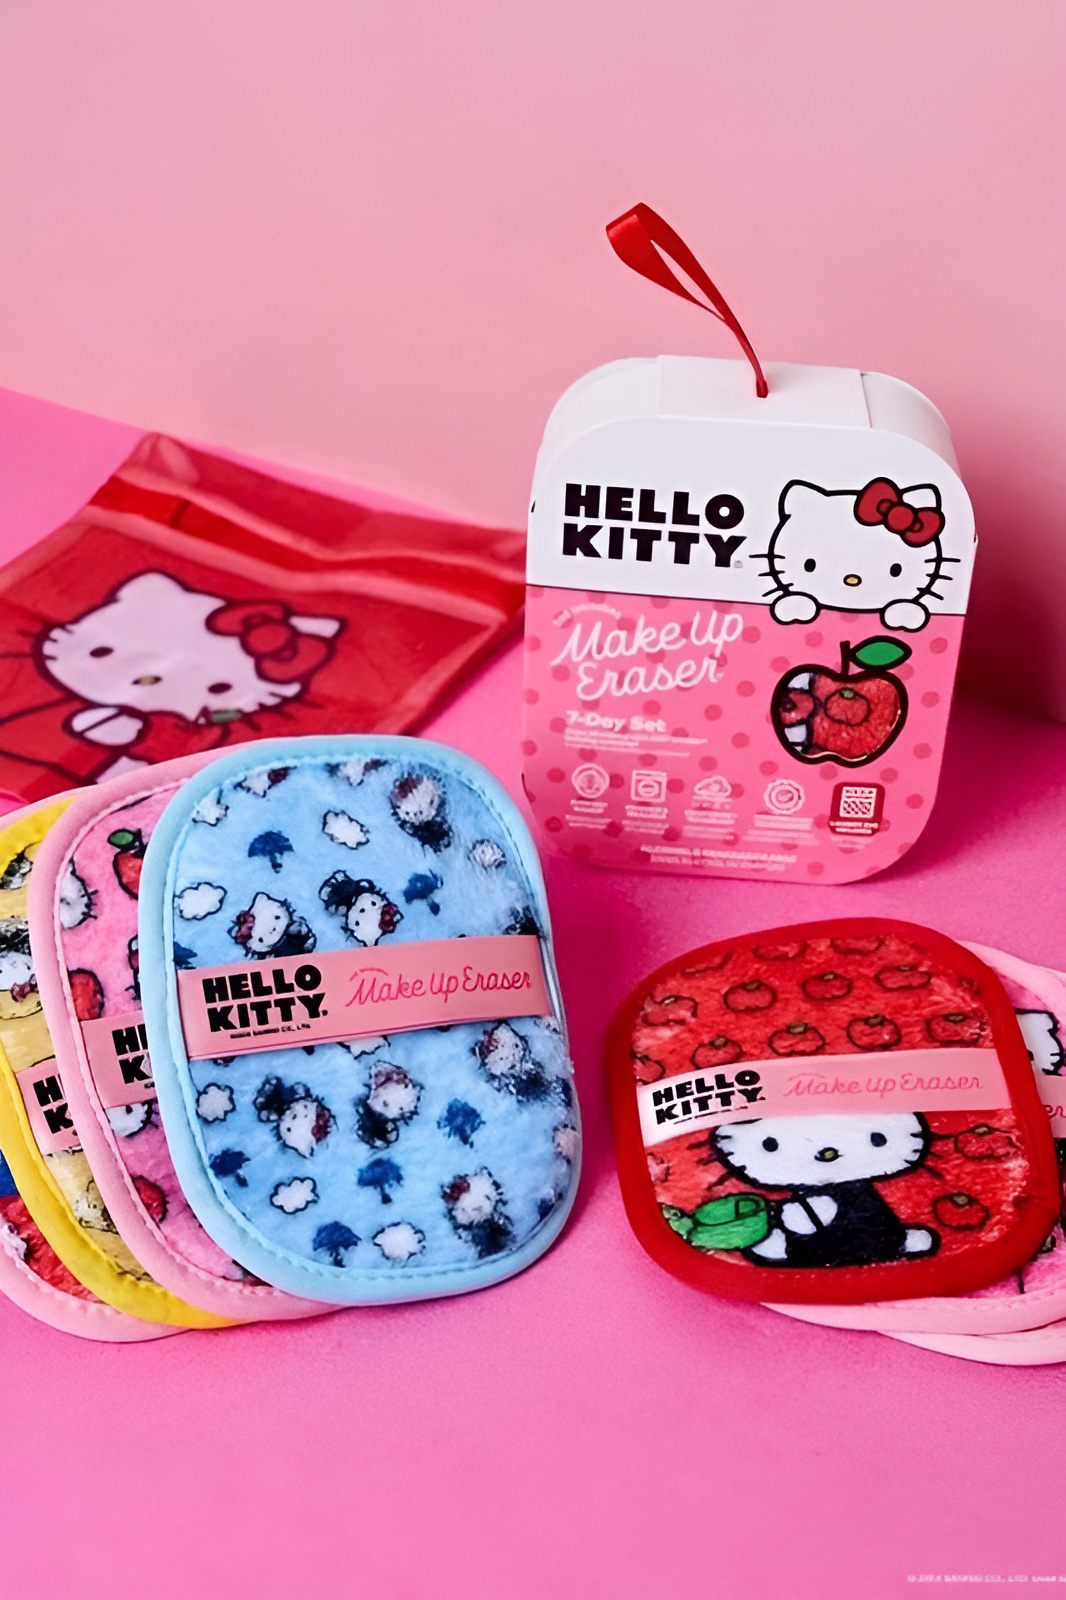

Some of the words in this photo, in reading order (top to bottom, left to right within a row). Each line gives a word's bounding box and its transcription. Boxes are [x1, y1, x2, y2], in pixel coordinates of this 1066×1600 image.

[564, 483, 745, 530] HELLO
[562, 522, 748, 568] KITTY
[550, 614, 687, 666] Make
[690, 609, 744, 658] Up
[575, 656, 721, 701] Eraser
[565, 709, 627, 733] 7-Day
[629, 715, 667, 733] Set
[202, 964, 322, 1004] HELLO
[345, 973, 427, 1008] Make
[430, 971, 459, 1004] Up
[462, 965, 532, 993] Eraser
[652, 1069, 761, 1107] HELLO
[783, 1076, 862, 1097] Make
[866, 1075, 896, 1099] Up
[900, 1072, 984, 1092] Eraser
